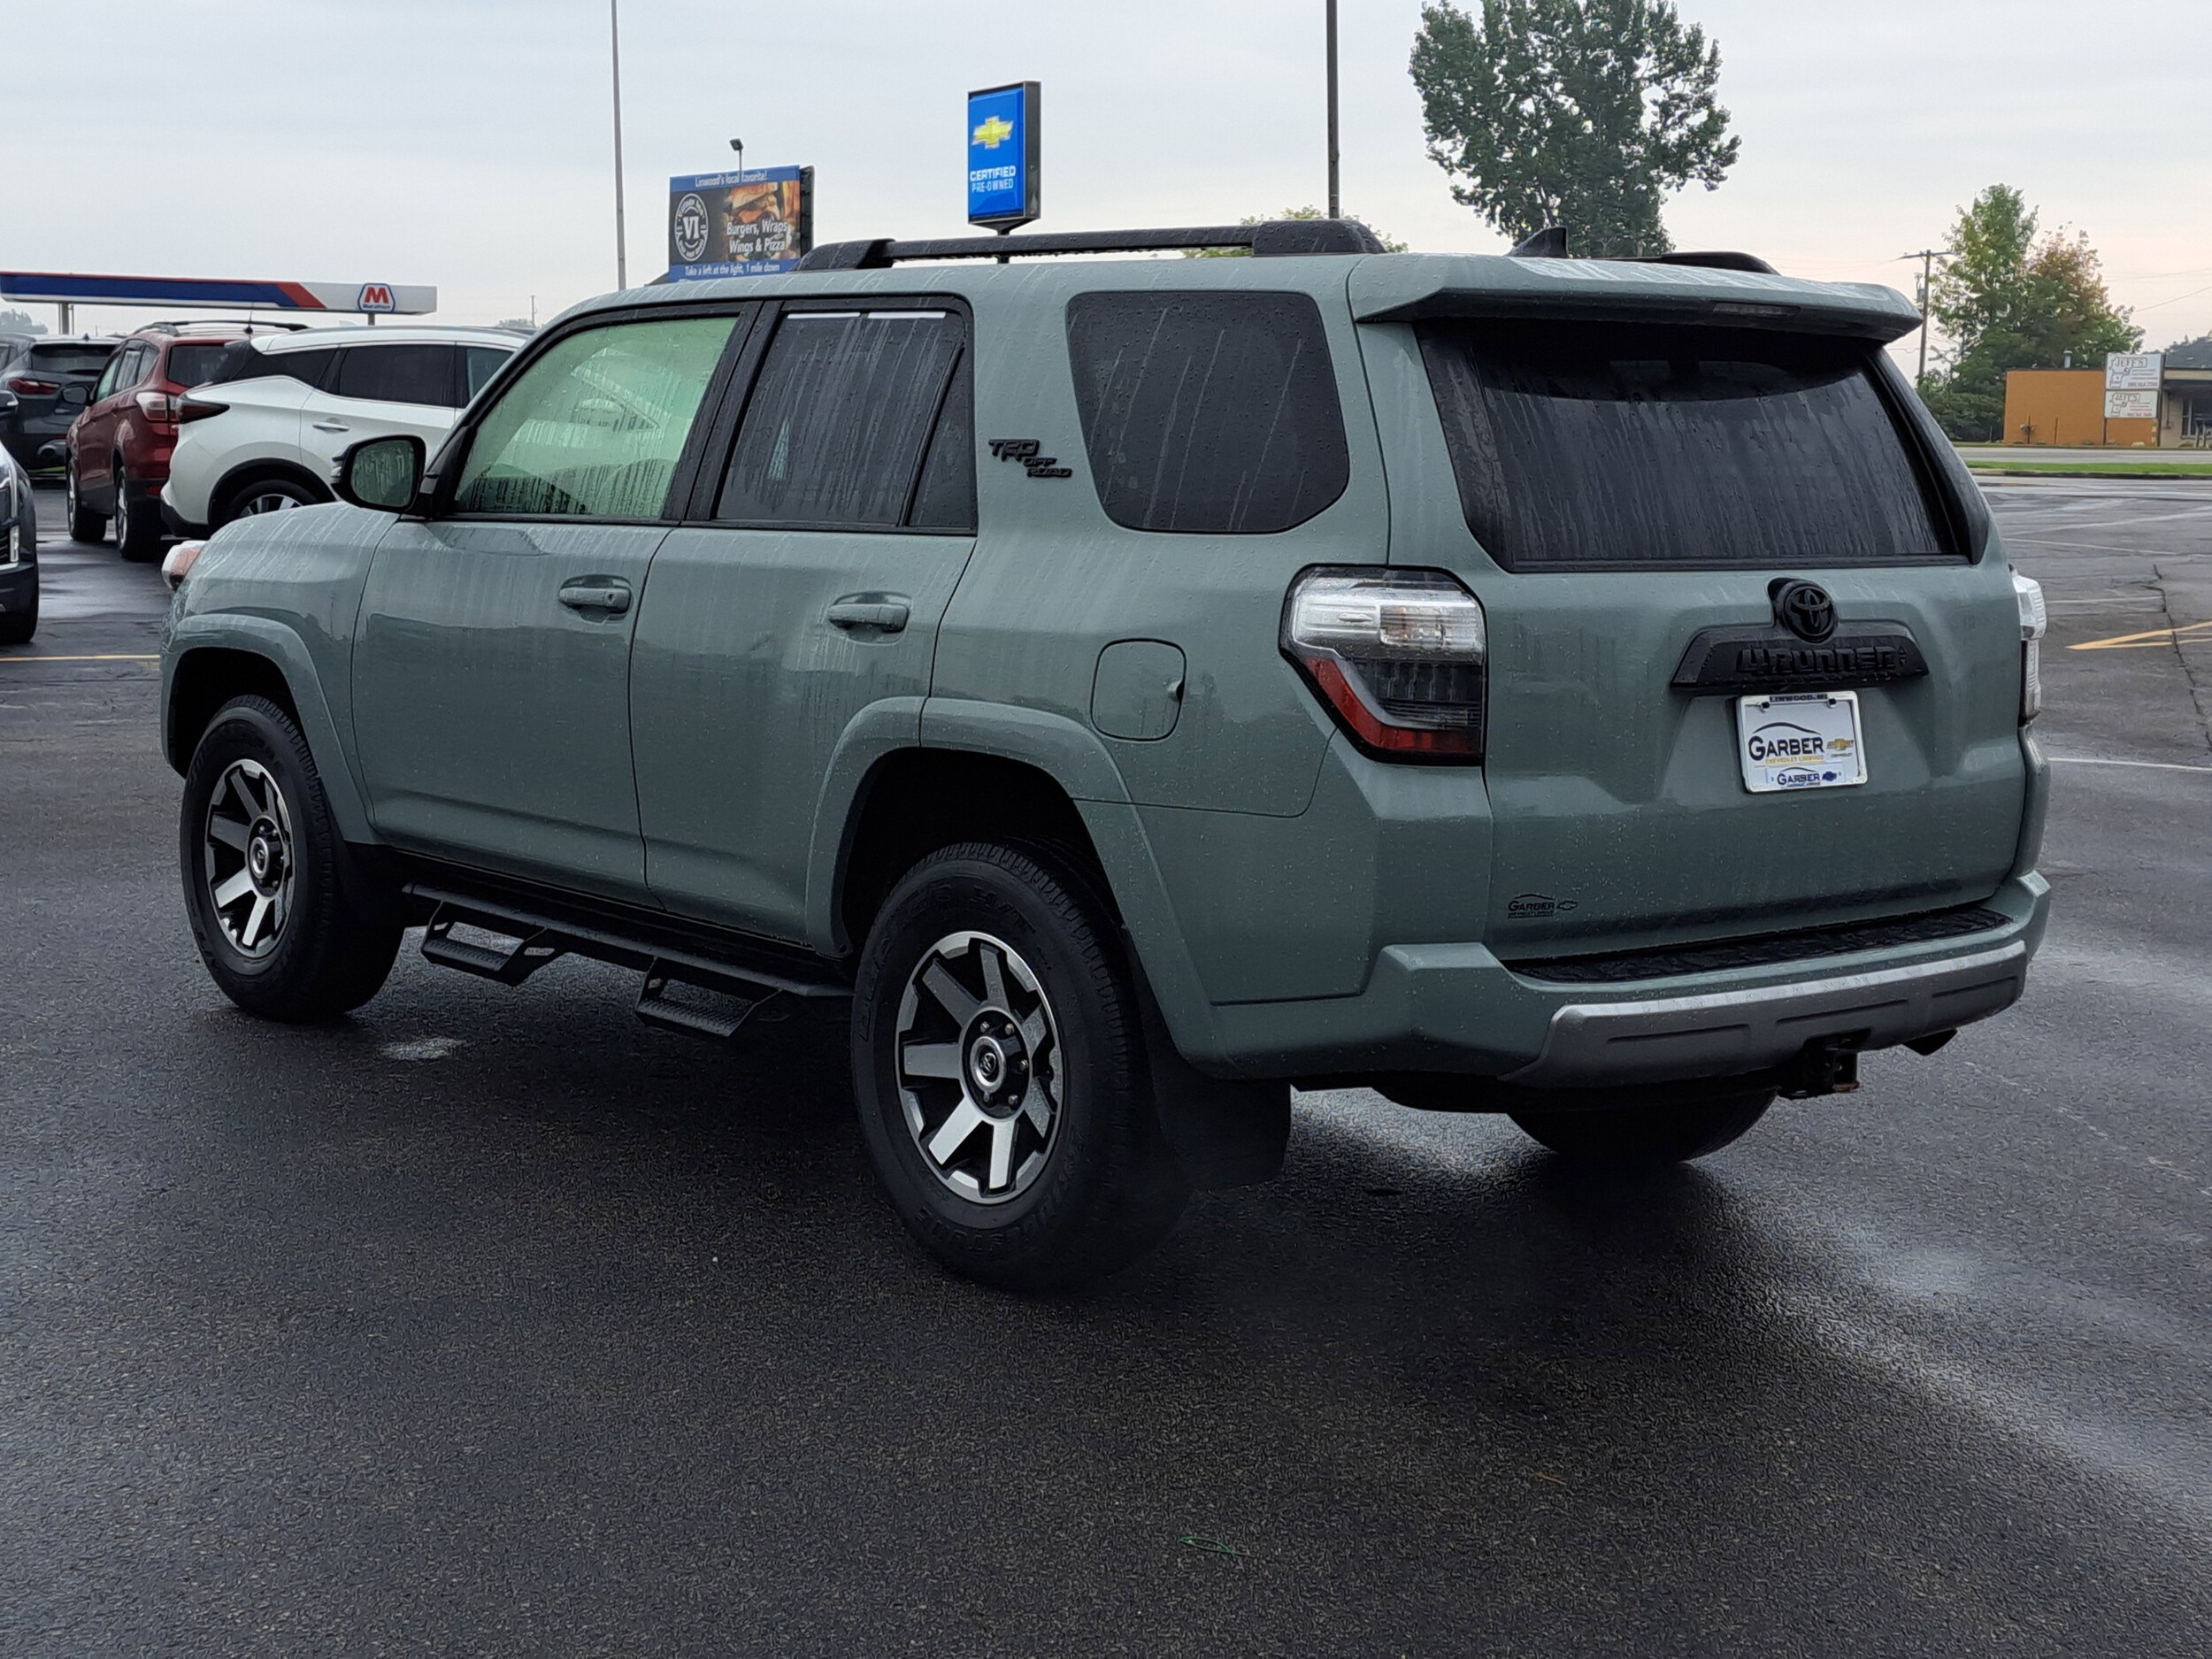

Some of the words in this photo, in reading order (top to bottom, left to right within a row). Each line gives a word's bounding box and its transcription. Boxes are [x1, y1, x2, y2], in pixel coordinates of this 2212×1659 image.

[726, 173, 740, 185] local
[970, 165, 1017, 180] CERTIFIED
[972, 179, 1014, 192] PRE-OWNED
[726, 221, 759, 238] Burgers,
[762, 219, 787, 235] Wraps
[729, 239, 754, 257] Wings
[756, 238, 763, 252] &
[764, 238, 786, 251] Pizza
[365, 287, 389, 303] M
[988, 439, 1040, 462] TRD
[1023, 457, 1057, 467] OFF
[1026, 467, 1073, 478] ROAD
[1740, 647, 1897, 674] 4RUNNER
[1748, 736, 1825, 761] GARBER
[1778, 772, 1821, 785] GARBER
[1509, 901, 1555, 911] GARBER
